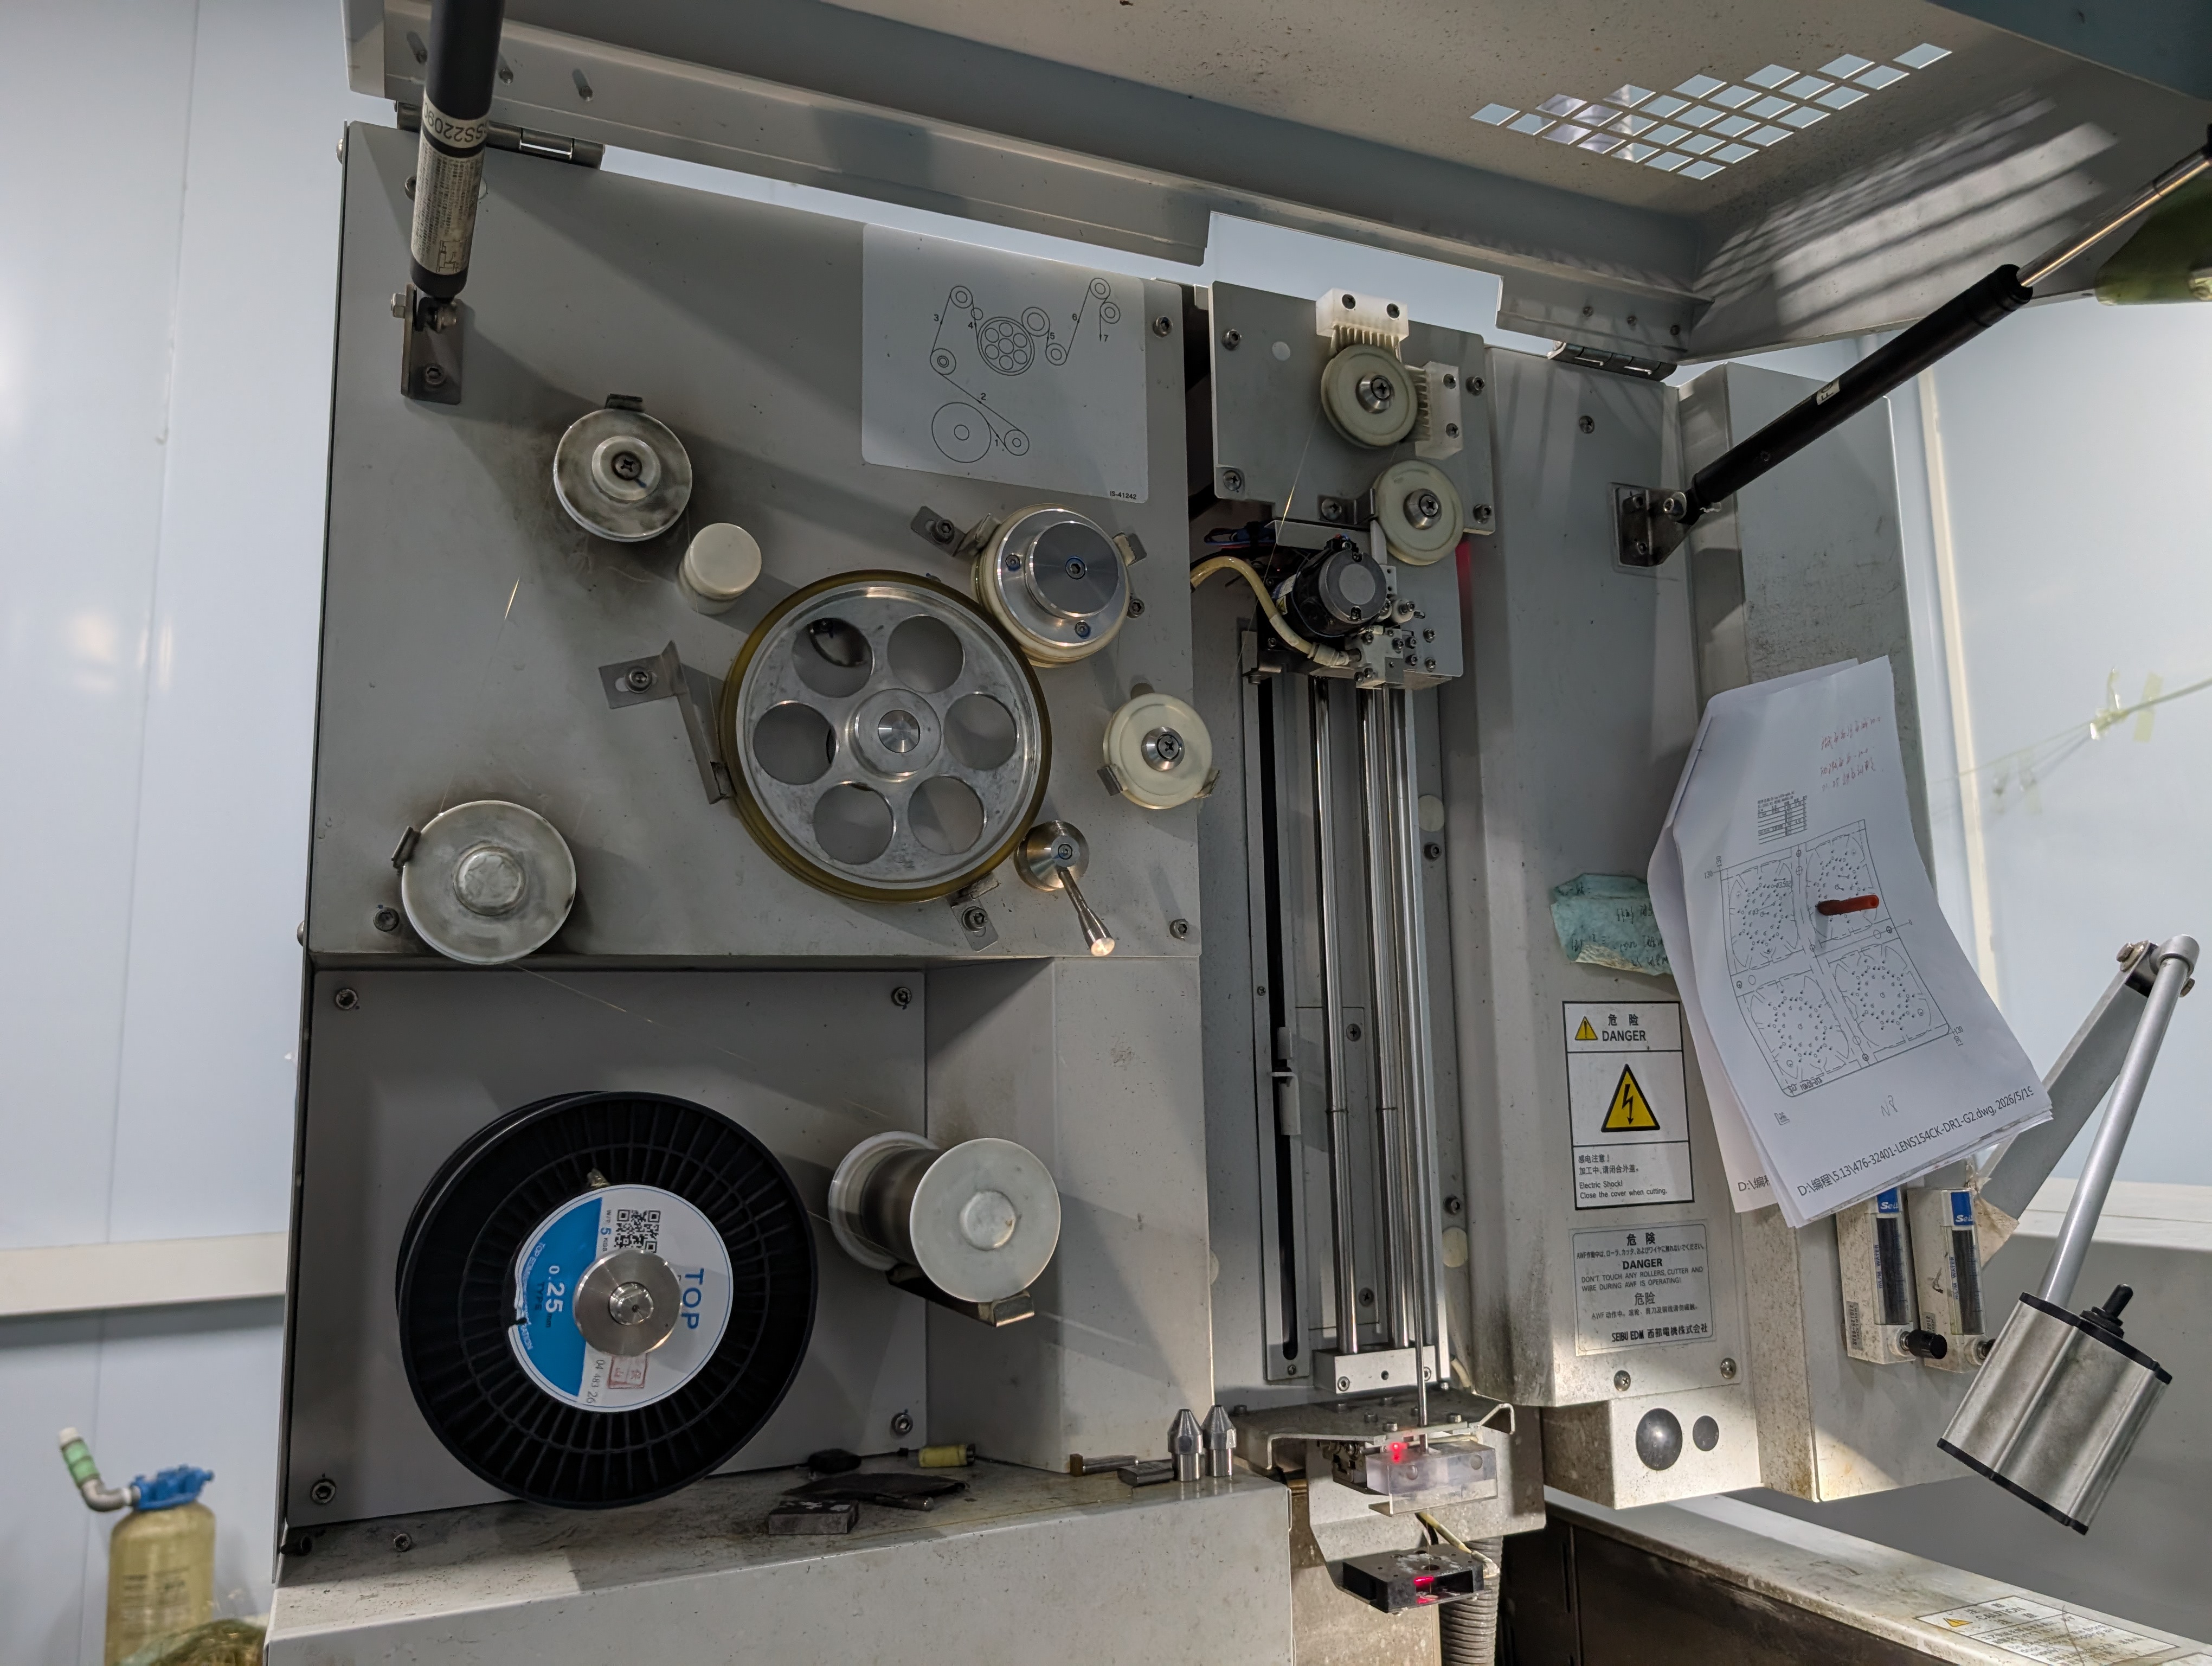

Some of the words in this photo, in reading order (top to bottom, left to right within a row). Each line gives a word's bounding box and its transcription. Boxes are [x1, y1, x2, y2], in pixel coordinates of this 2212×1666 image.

[1110, 490, 1137, 499] IS-41242
[1704, 870, 1713, 879] 130
[1602, 1030, 1646, 1041] DANGER
[1953, 1026, 1964, 1035] 130
[1603, 1180, 1623, 1188] Shock!
[1646, 1188, 1668, 1196] cutting.
[1622, 1258, 1663, 1270] DANGER
[1648, 1277, 1681, 1285] OPERATING!
[545, 1265, 565, 1313] 0.25
[535, 1281, 545, 1311] TYPE
[681, 1268, 704, 1329] TOP
[1635, 1291, 1655, 1306] 危险
[1612, 1331, 1628, 1342] SEIBU
[1630, 1329, 1644, 1340] EDM
[1975, 1606, 2026, 1620] CAUTION
